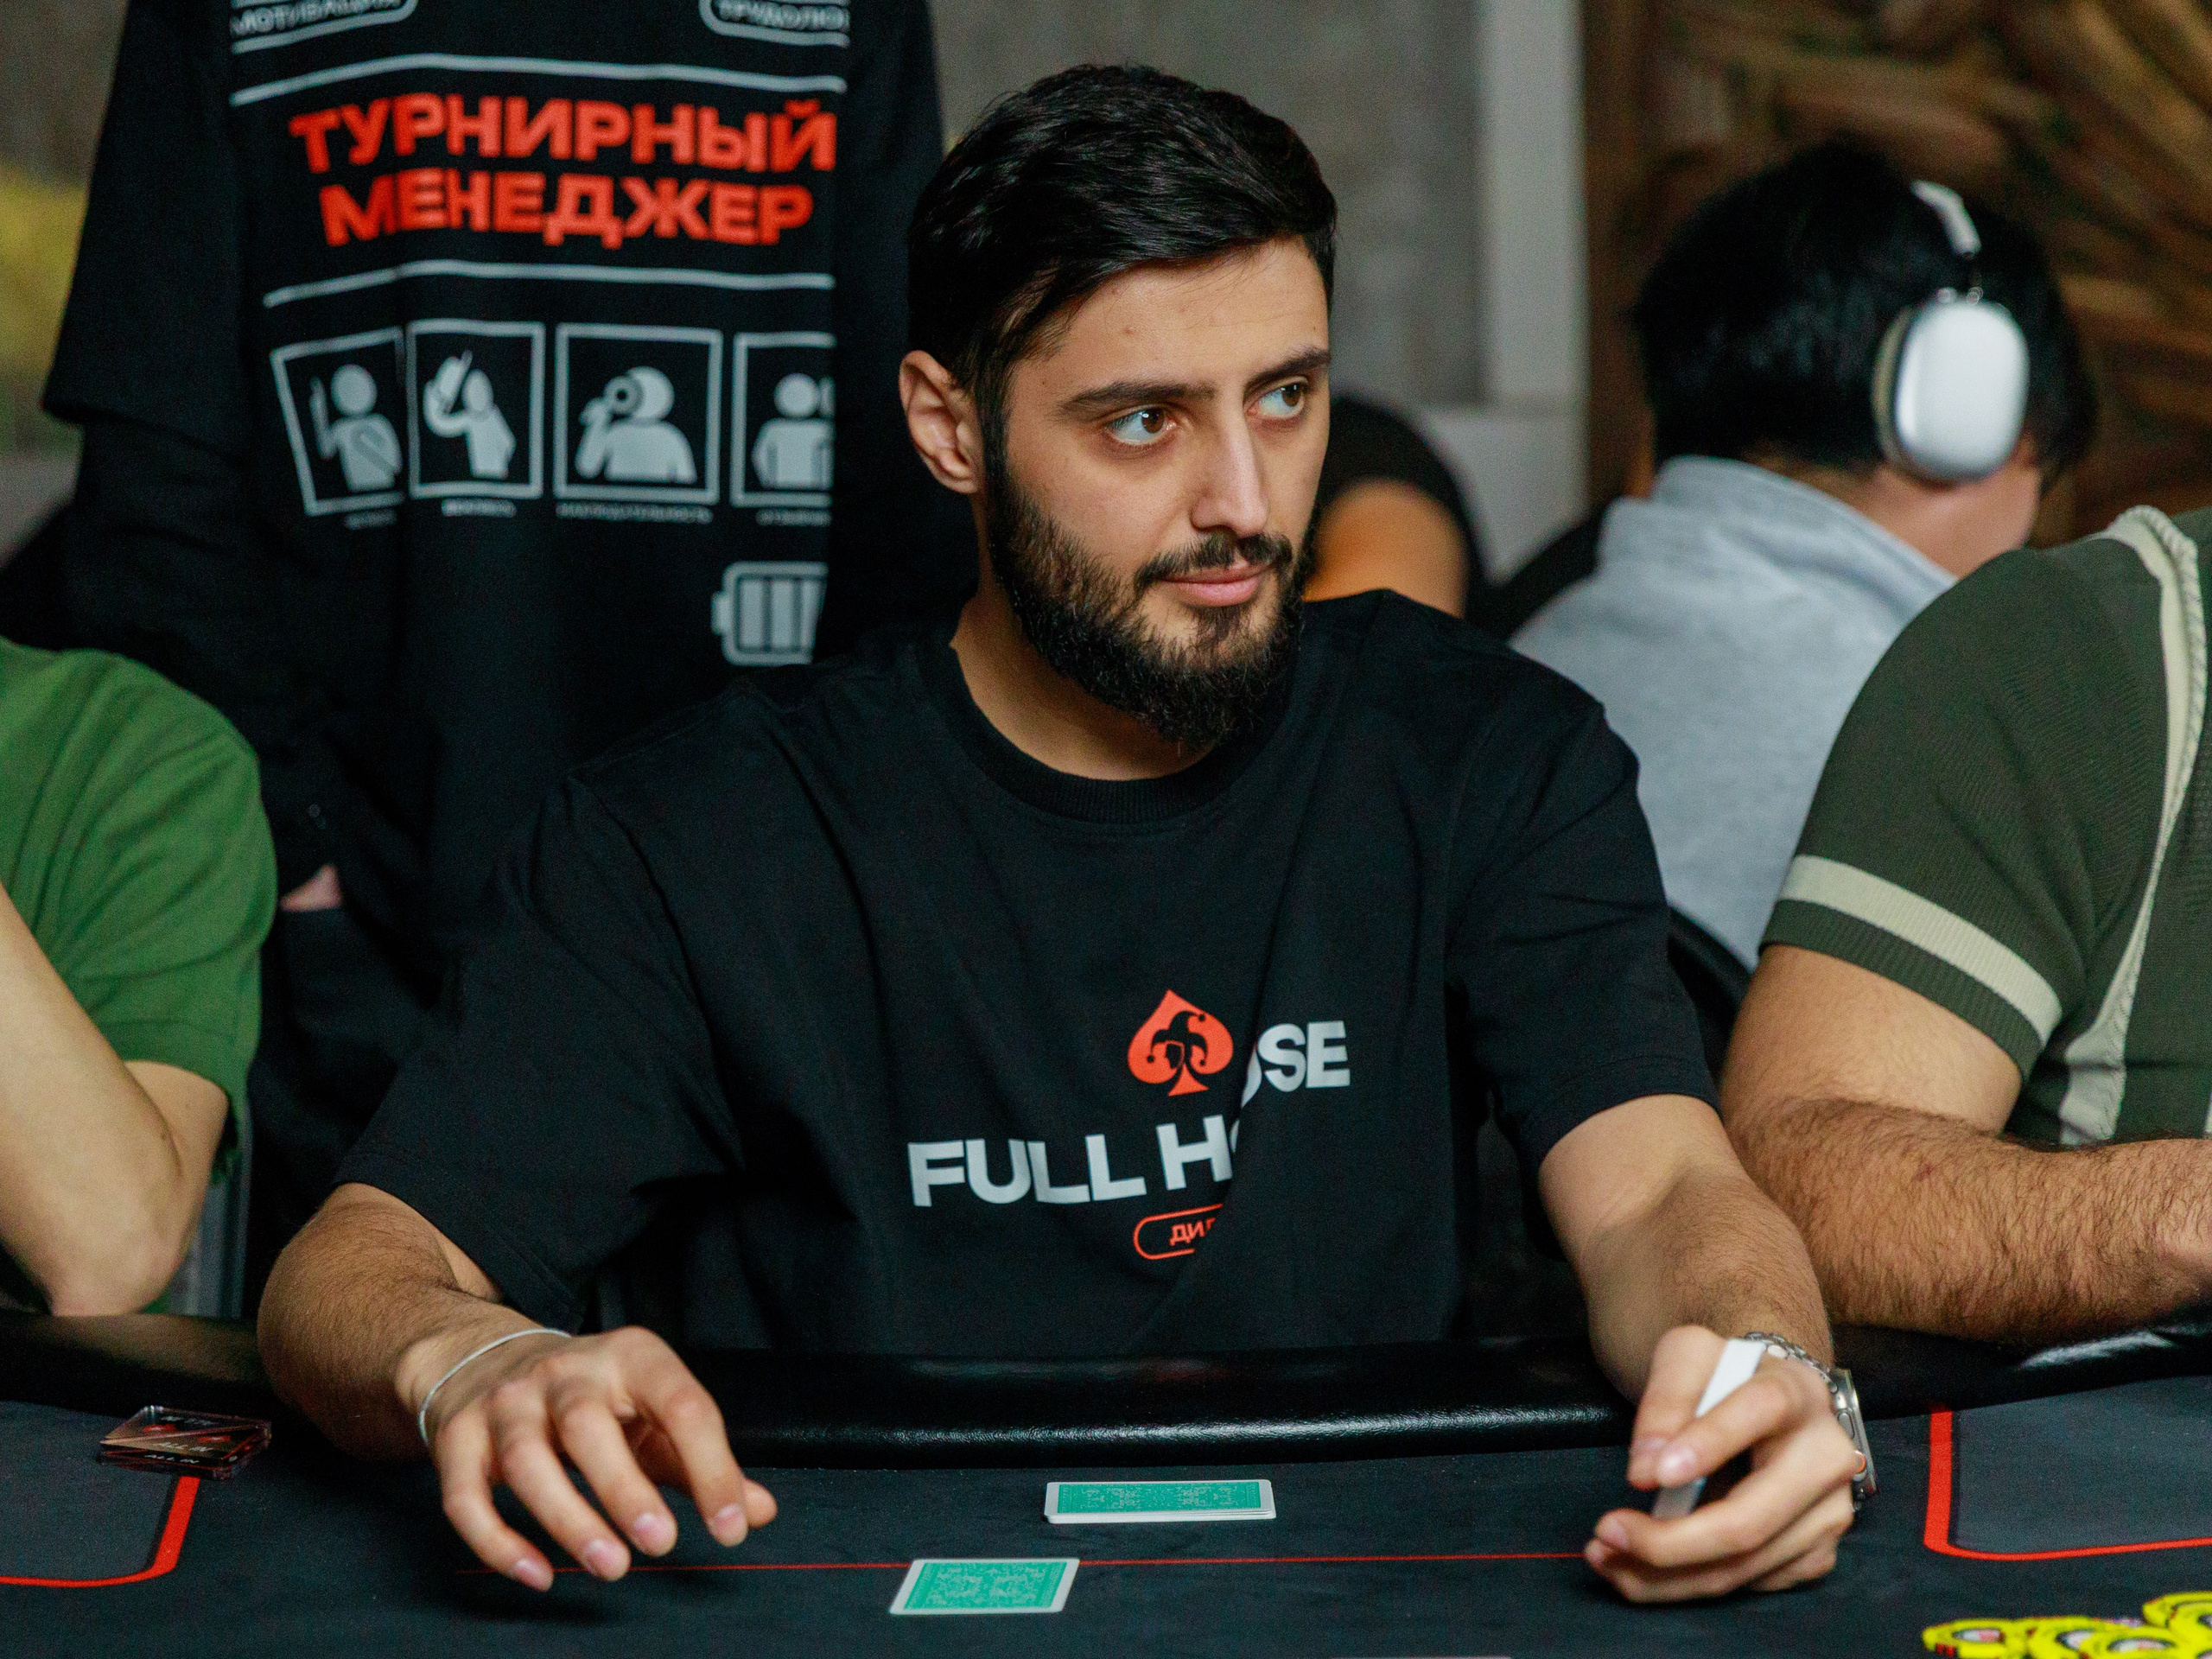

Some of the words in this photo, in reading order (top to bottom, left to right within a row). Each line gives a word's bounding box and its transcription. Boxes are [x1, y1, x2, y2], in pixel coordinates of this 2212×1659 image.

[289, 92, 837, 174] ТУРНИРНЫЙ
[319, 168, 814, 249] МЕНЕДЖЕР
[908, 1134, 1147, 1207] FULL
[1156, 1020, 1351, 1191] HSE
